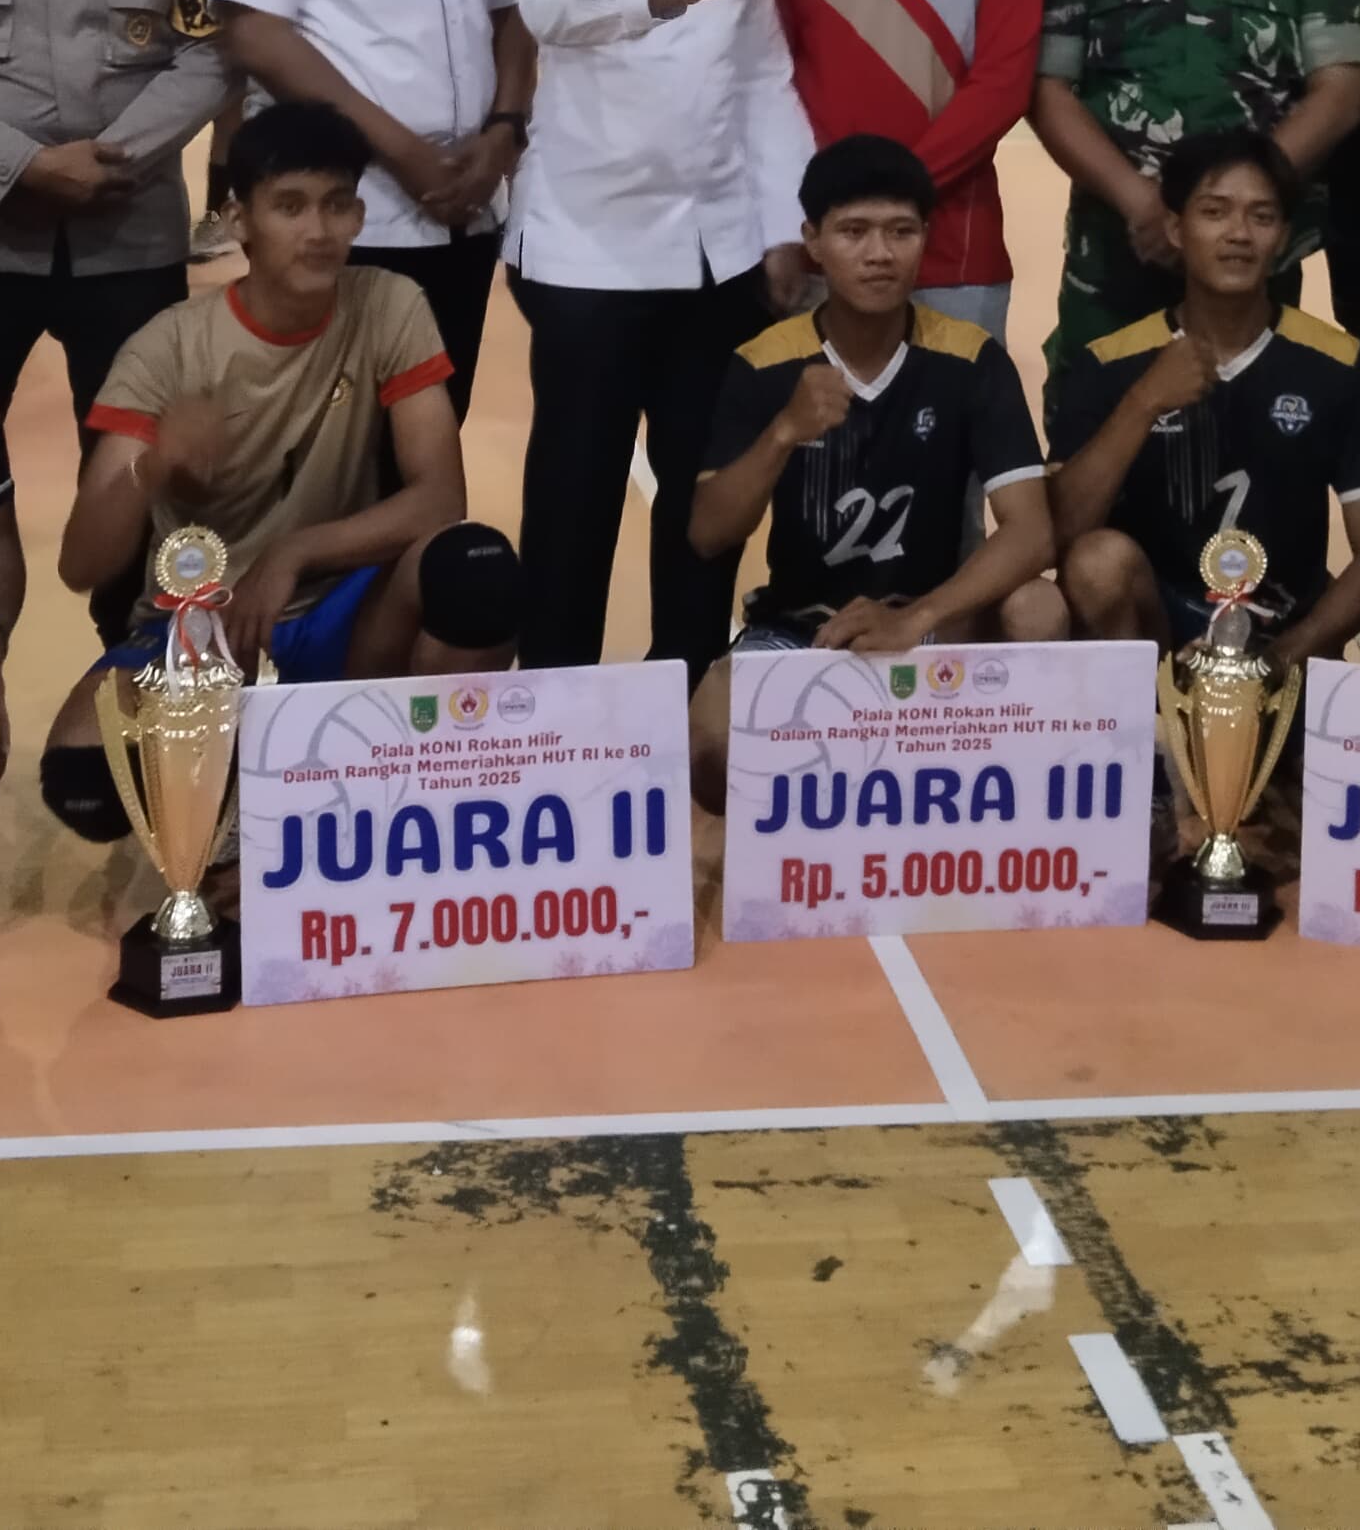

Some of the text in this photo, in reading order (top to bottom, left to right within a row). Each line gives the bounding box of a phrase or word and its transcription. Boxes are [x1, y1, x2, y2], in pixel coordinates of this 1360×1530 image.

[823, 485, 914, 566] 22
[770, 718, 1117, 742] Dalam Rangka Memeriahkan HUT RI ke 80
[852, 704, 1034, 722] Piala KONI Rokan Hilir
[283, 744, 651, 785] Dalam Rangka Memeriahkan HUT RI ke 80
[371, 731, 563, 759] Piala KONI Rokan Hilir
[896, 738, 992, 754] Tahun 2025
[419, 771, 521, 791] Tahun 2025
[754, 762, 1123, 834] JUARA III
[262, 787, 666, 889] JUARA II
[781, 846, 1108, 909] Rp. 5.000.000,-
[301, 885, 649, 966] Rp. 7.000.000,-
